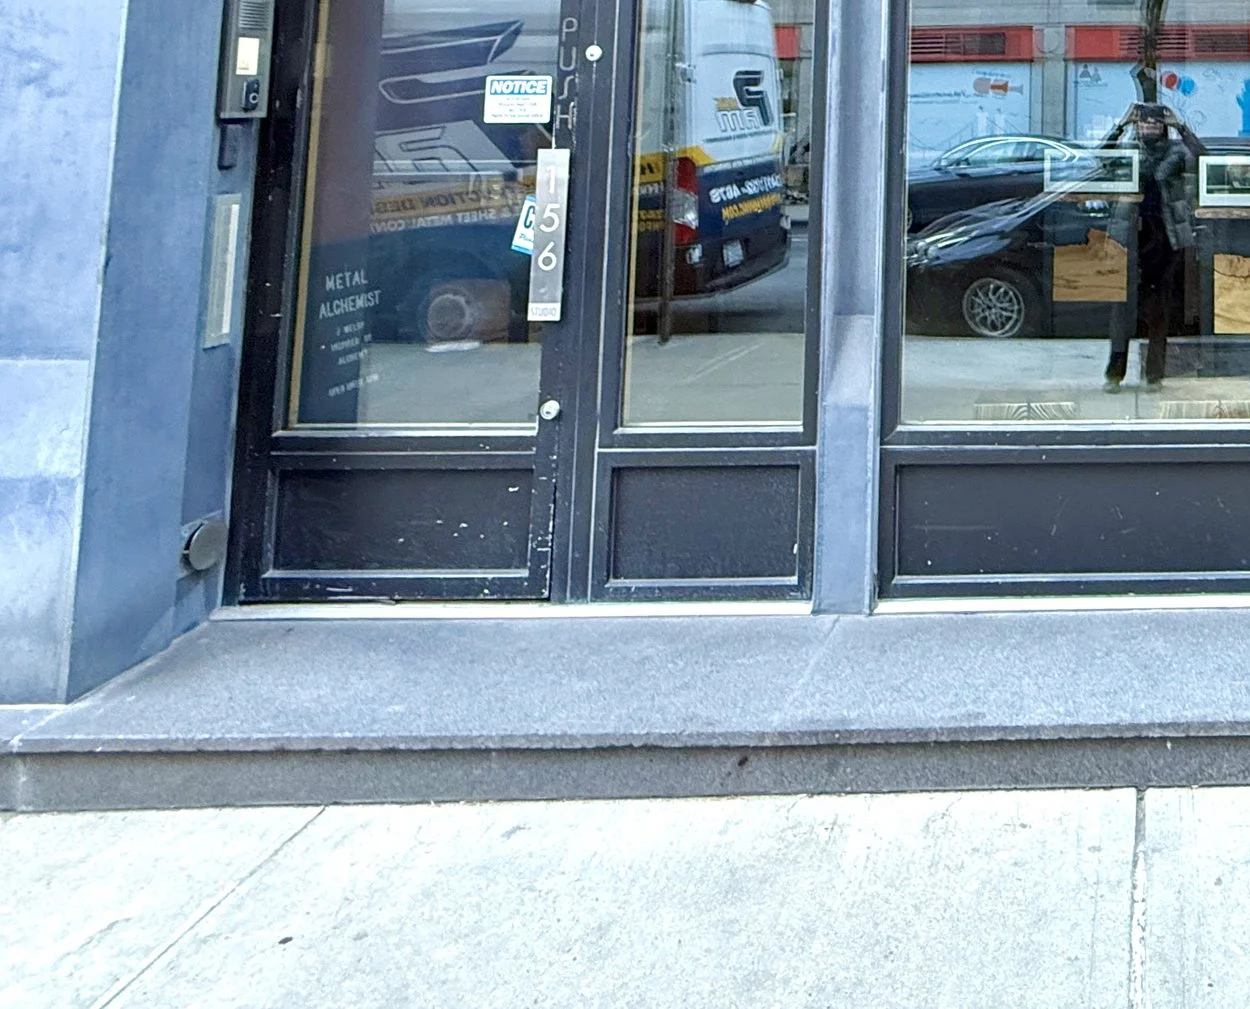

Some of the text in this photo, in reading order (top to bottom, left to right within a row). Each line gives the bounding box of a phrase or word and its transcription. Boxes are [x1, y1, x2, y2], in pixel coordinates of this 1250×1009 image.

[490, 79, 548, 95] NOTICE
[555, 17, 578, 129] PUSH
[537, 164, 561, 271] 156
[325, 269, 369, 292] METAL
[319, 290, 382, 319] ALCHEMIST
